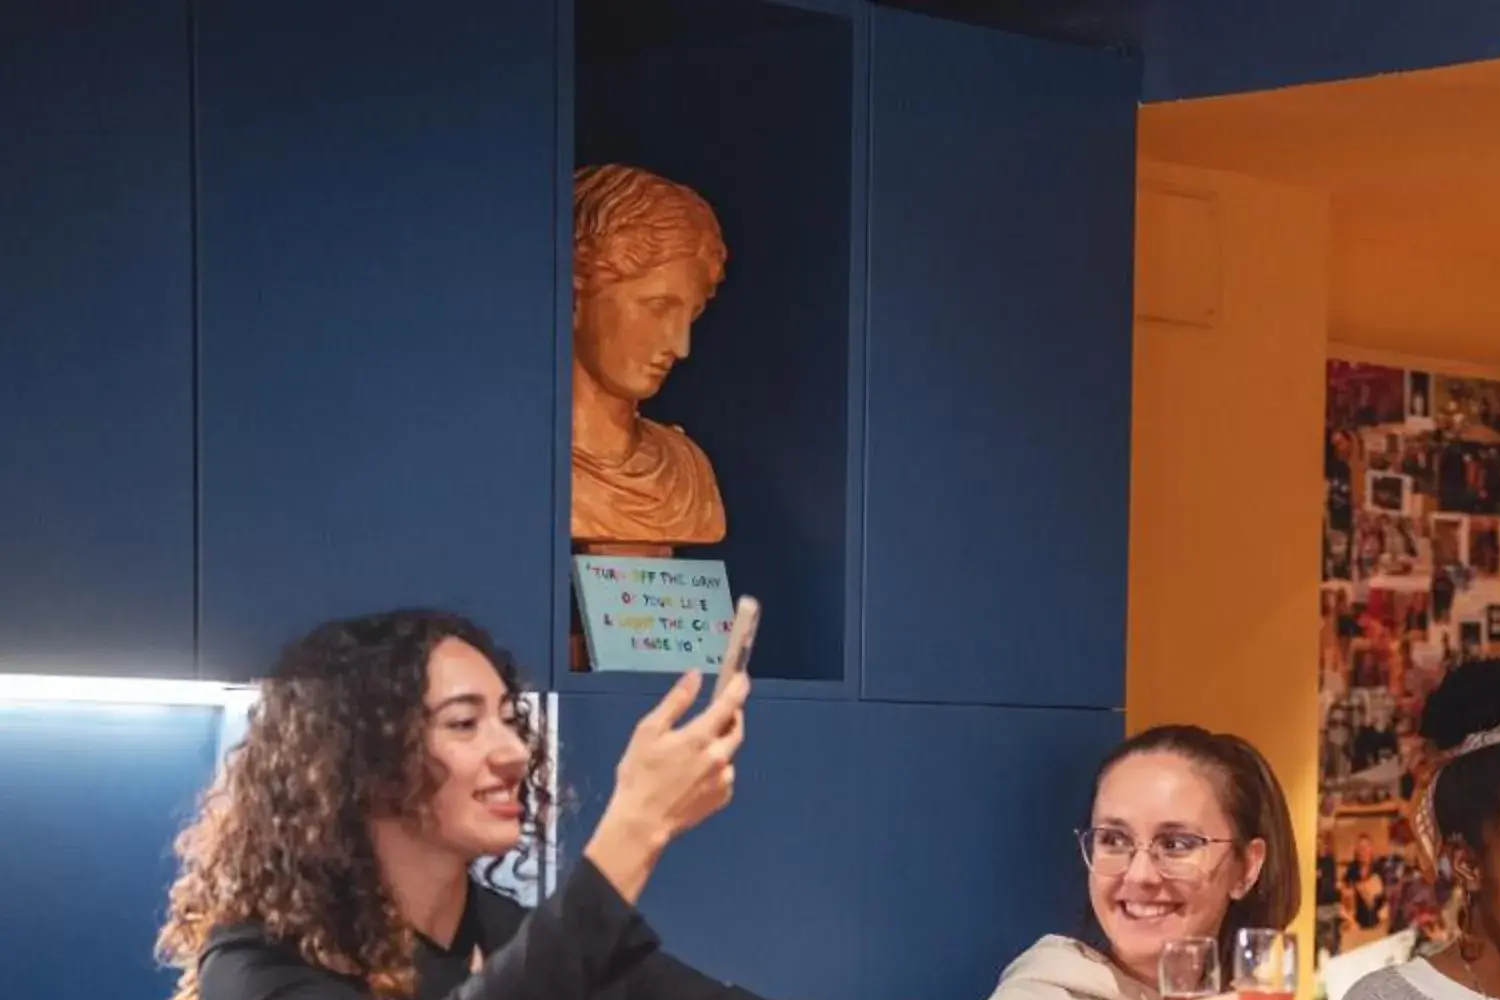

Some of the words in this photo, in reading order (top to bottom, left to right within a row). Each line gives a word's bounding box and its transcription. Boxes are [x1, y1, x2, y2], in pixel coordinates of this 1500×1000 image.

[660, 571, 685, 586] THE
[680, 597, 708, 612] LIE
[659, 616, 684, 632] THE
